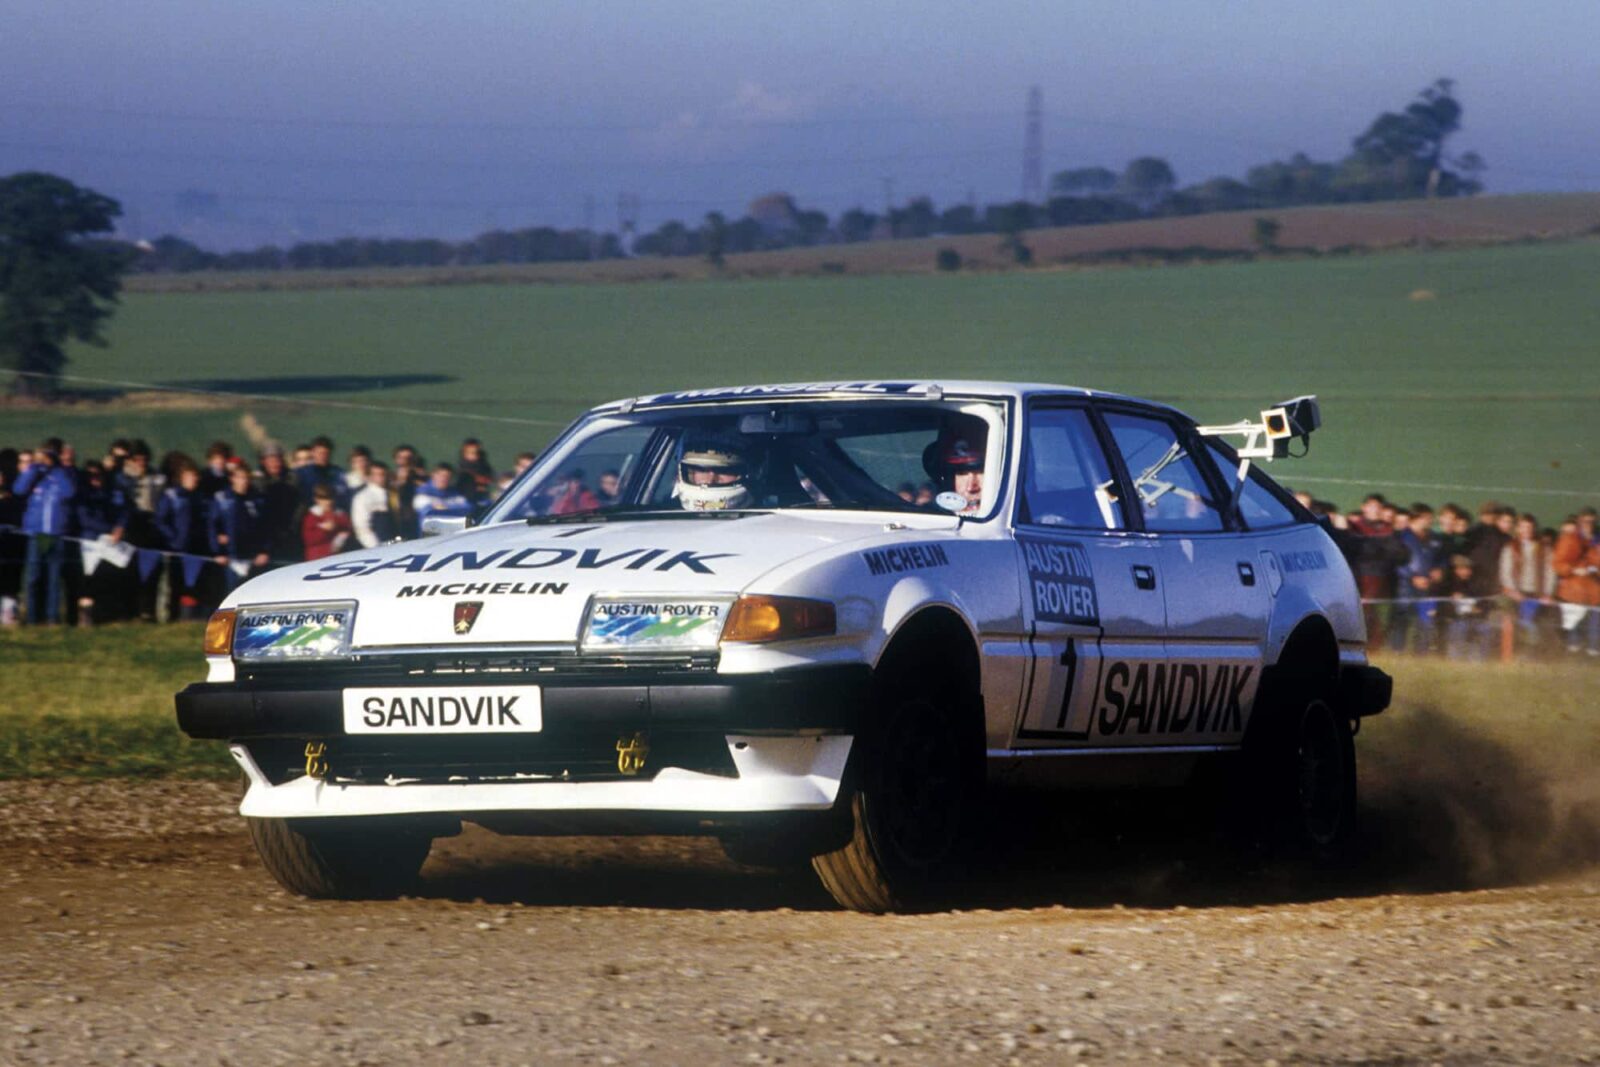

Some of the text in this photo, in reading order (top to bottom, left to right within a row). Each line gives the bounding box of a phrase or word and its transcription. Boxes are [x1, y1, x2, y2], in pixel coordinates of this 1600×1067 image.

[303, 547, 742, 581] SANDVIK
[863, 544, 950, 576] MICHELIN
[1024, 542, 1092, 578] AUSTIN
[397, 582, 569, 598] MICHELIN
[1034, 580, 1096, 618] ROVER
[241, 612, 345, 628] AUSTIN ROVER
[598, 603, 720, 617] AUSTIN ROVER
[1056, 636, 1078, 729] 1
[1097, 661, 1254, 737] SANDVIK
[362, 696, 523, 728] SANDVIK
